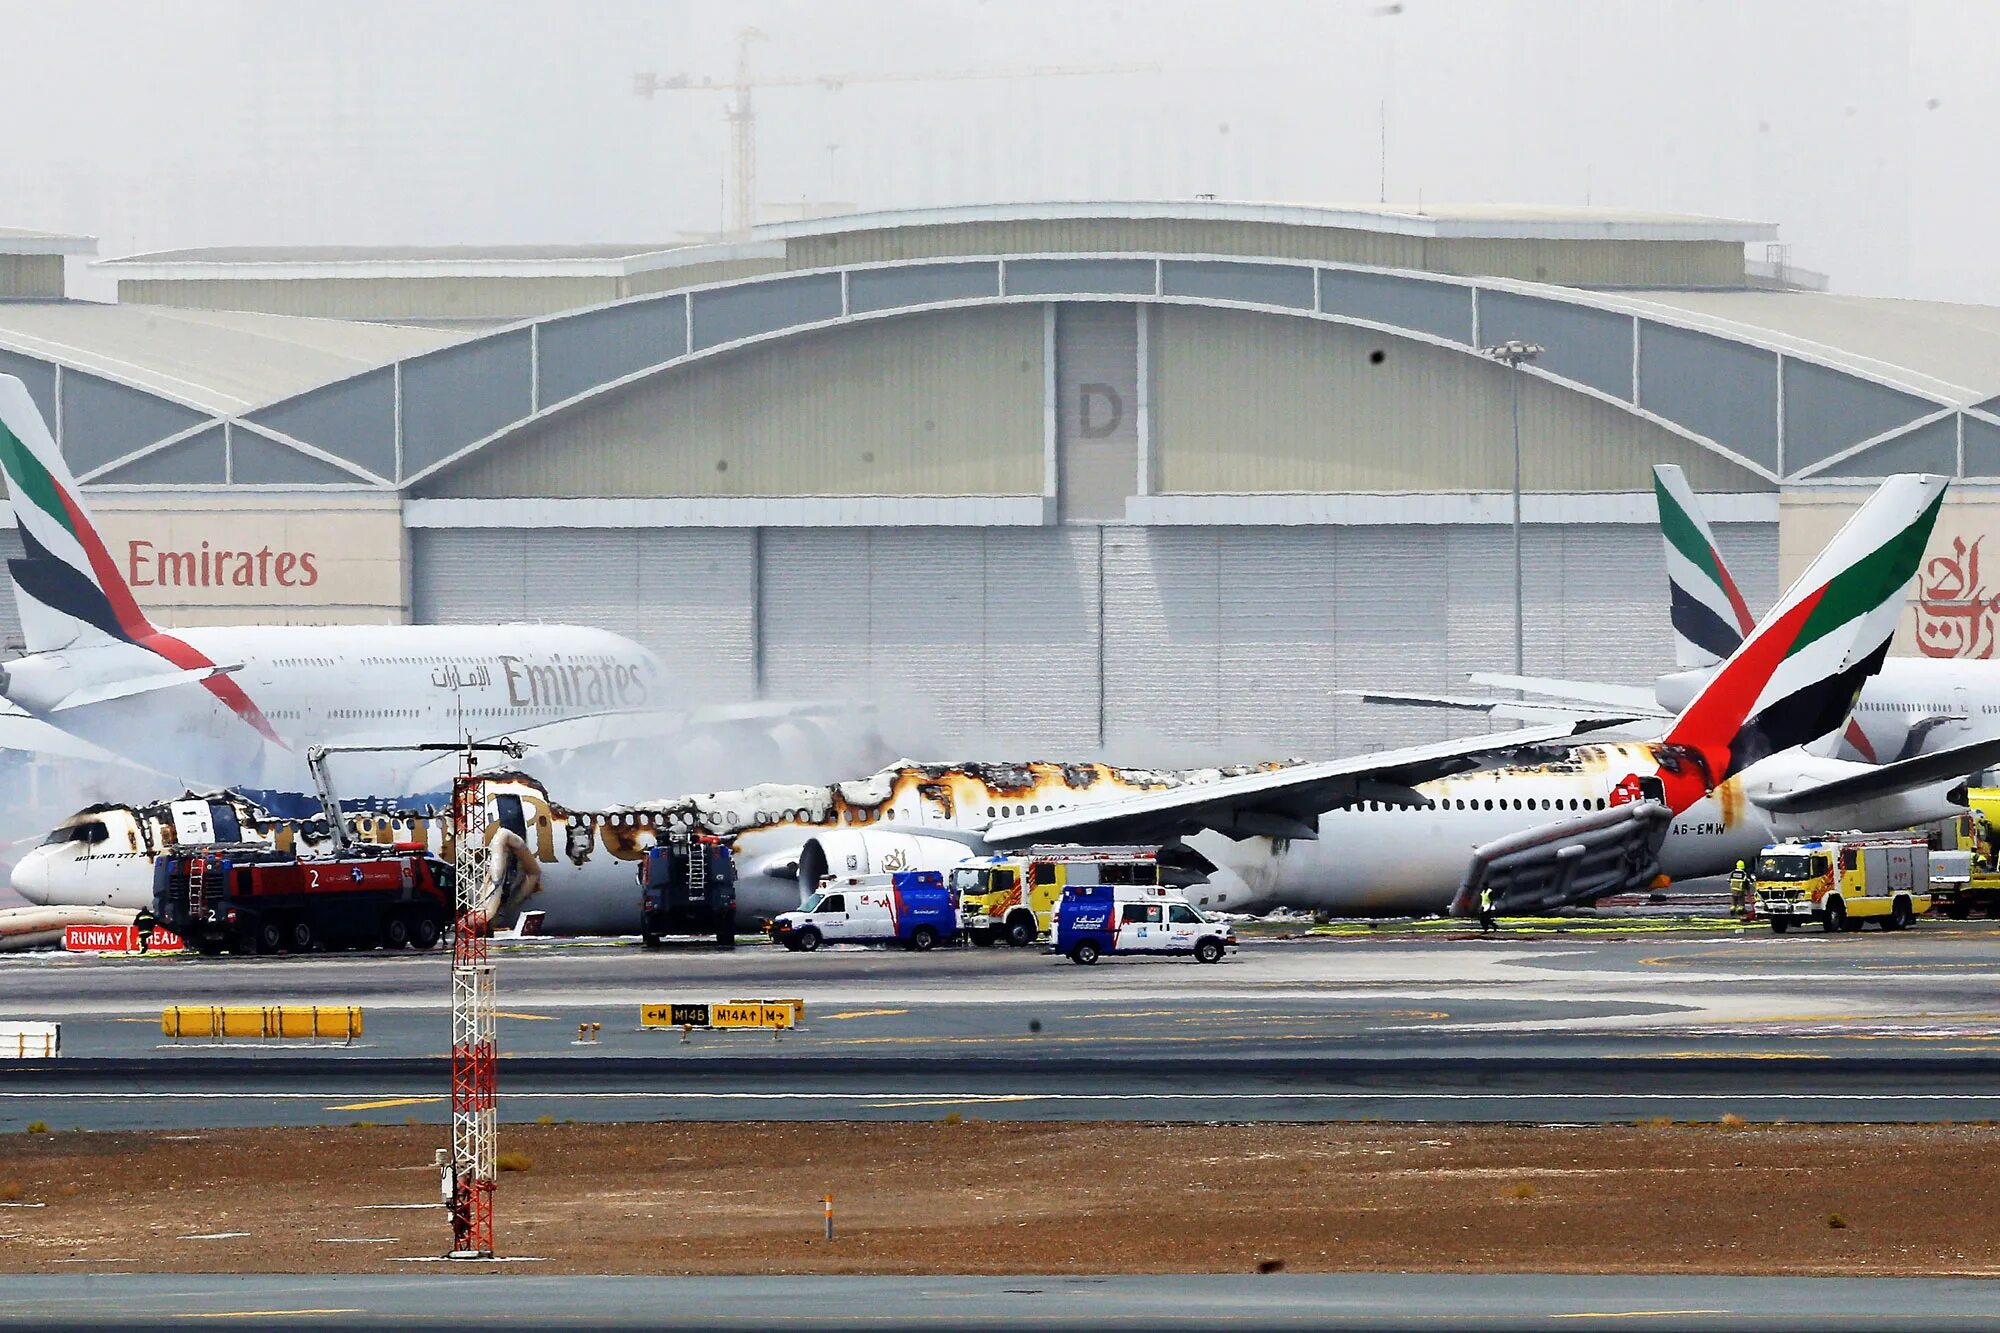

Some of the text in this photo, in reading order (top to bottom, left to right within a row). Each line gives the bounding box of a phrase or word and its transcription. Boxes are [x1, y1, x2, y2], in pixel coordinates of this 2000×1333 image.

[1080, 383, 1122, 438] D
[128, 540, 318, 587] Emirates
[499, 653, 647, 707] Emirates
[1673, 823, 1726, 835] A6-EMW
[309, 869, 319, 888] 2
[208, 909, 216, 922] 2
[71, 931, 122, 946] RUNWAY
[658, 1009, 705, 1021] M M14B
[717, 1009, 775, 1021] M14A M
